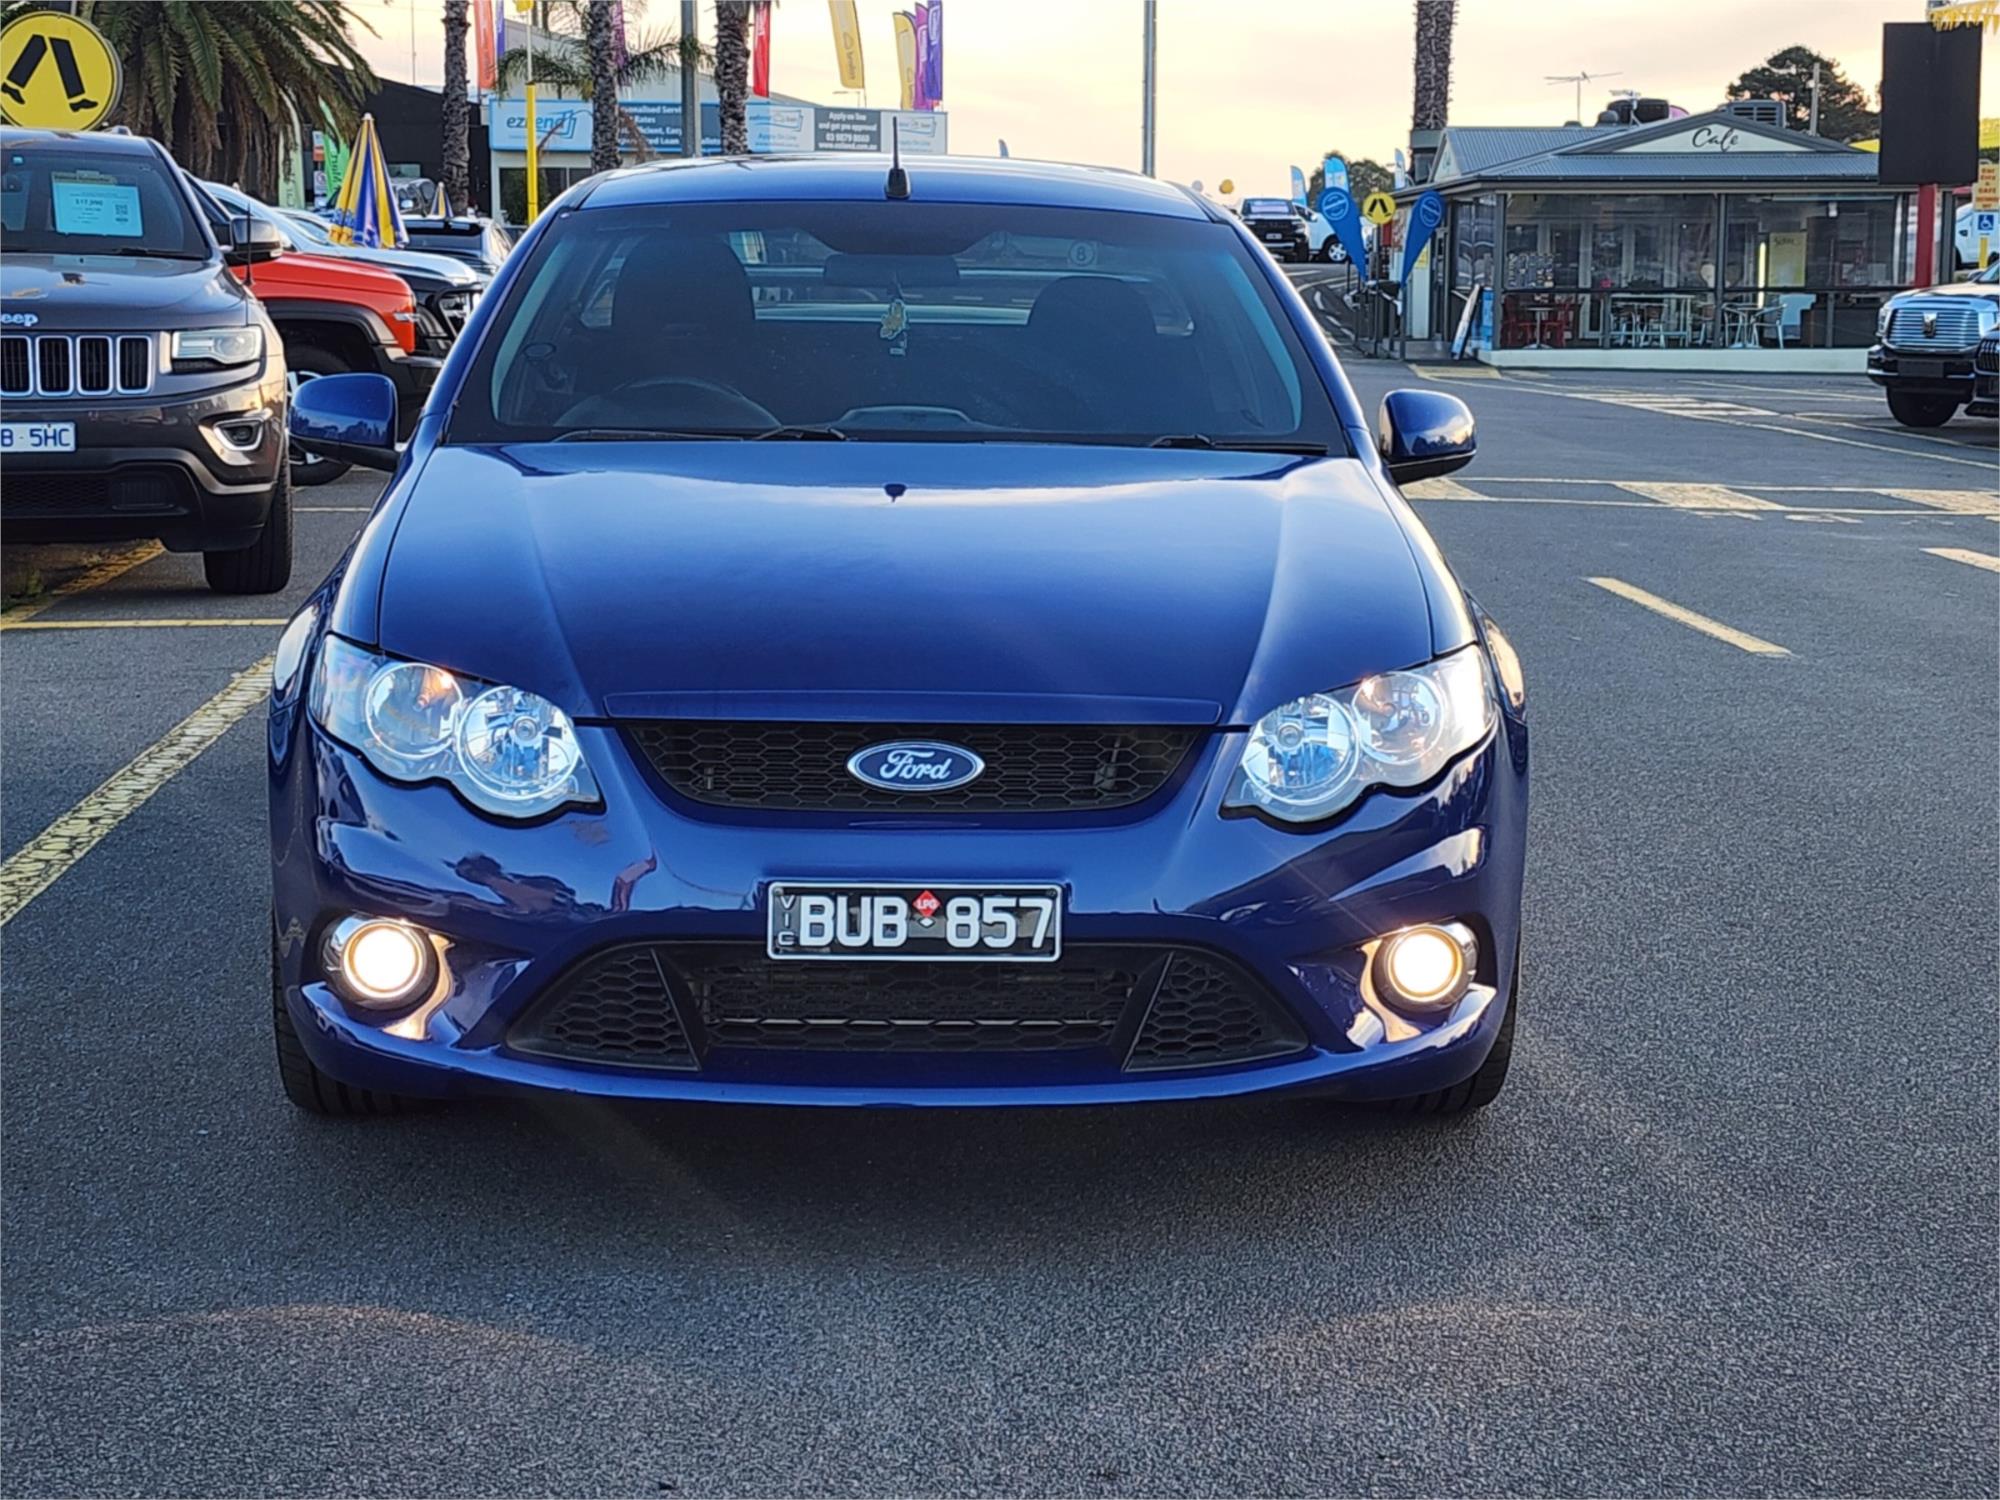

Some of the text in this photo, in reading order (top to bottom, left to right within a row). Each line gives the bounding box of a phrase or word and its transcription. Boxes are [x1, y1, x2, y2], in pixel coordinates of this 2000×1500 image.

[829, 112, 846, 121] Apply
[1692, 127, 1739, 152] Cafe
[1, 313, 39, 327] eep
[29, 428, 70, 447] 5HC
[879, 749, 952, 780] Ford
[913, 898, 940, 910] LPG
[777, 895, 796, 946] VIC
[799, 896, 1054, 949] BUB 857
